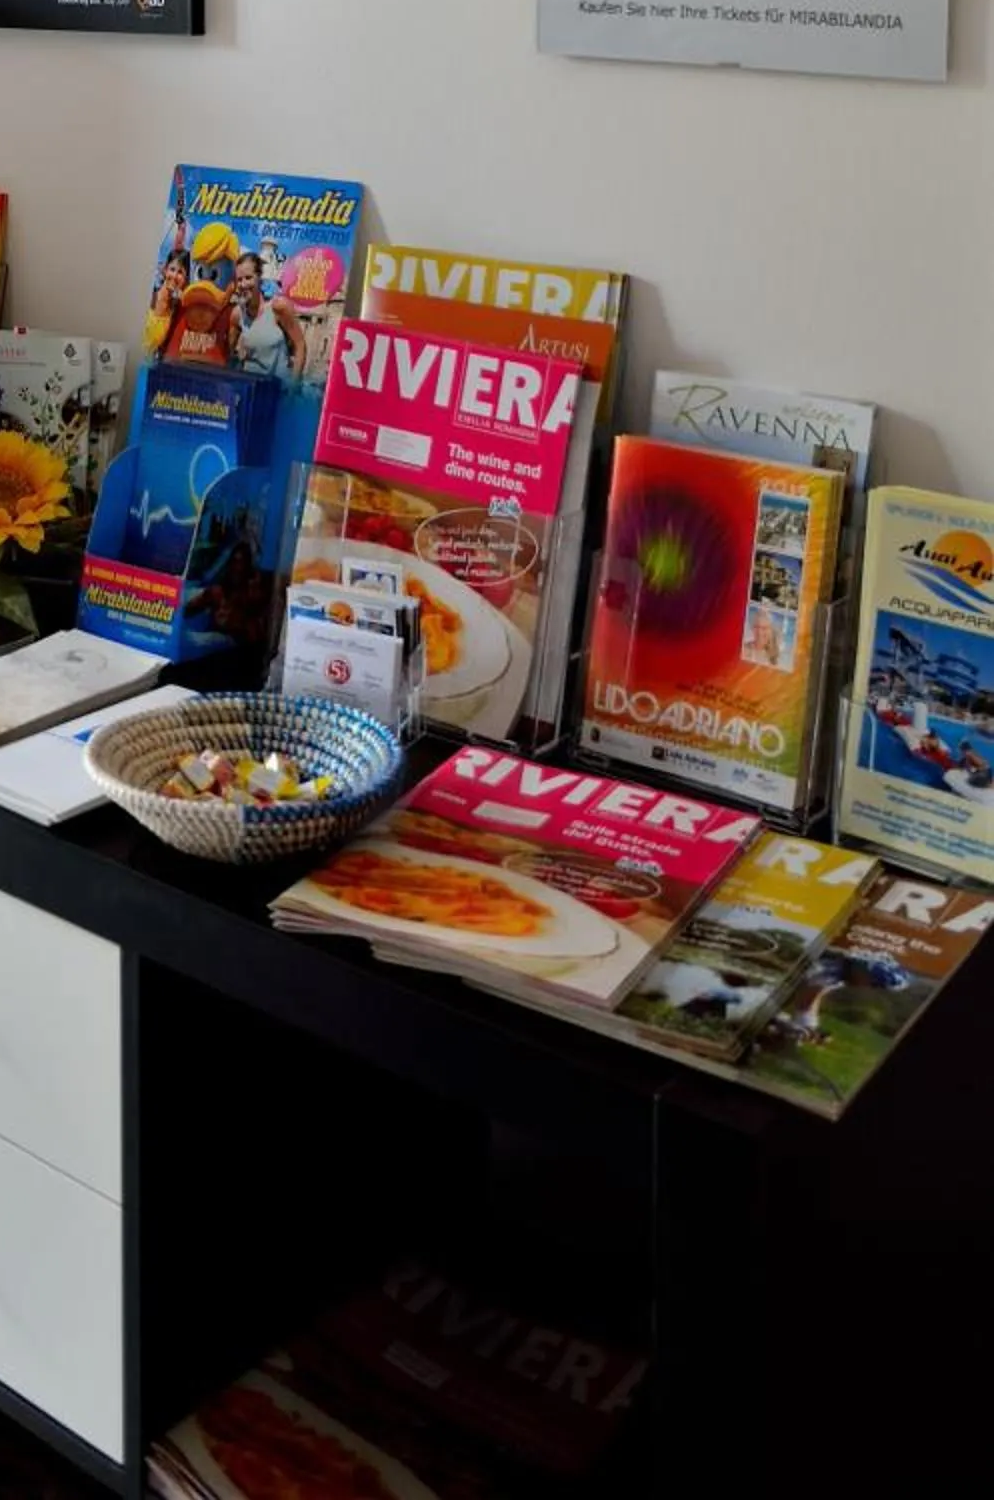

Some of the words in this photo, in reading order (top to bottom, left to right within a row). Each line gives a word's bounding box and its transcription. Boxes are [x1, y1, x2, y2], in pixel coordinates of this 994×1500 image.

[579, 1, 623, 16] Kaufen
[626, 2, 646, 17] Sie
[650, 3, 674, 18] hier
[679, 5, 707, 20] Ihre
[713, 6, 760, 24] Tickets
[764, 8, 785, 24] für
[790, 11, 903, 30] MIRABILANDIA
[188, 180, 356, 226] Mirabilandia
[341, 327, 579, 433] RIVIERA
[151, 389, 230, 420] Mirabilandia
[668, 384, 850, 452] RAVENNA
[445, 461, 475, 481] dine
[477, 471, 527, 493] routes.
[447, 442, 474, 463] The
[477, 452, 510, 471] wine
[513, 462, 542, 479] and
[85, 583, 175, 622] Mirabilandia
[889, 595, 994, 631] ACQUAPAR
[592, 680, 659, 723] LIDO
[657, 700, 786, 758] ADRIANO
[454, 748, 762, 845] RIVIERA
